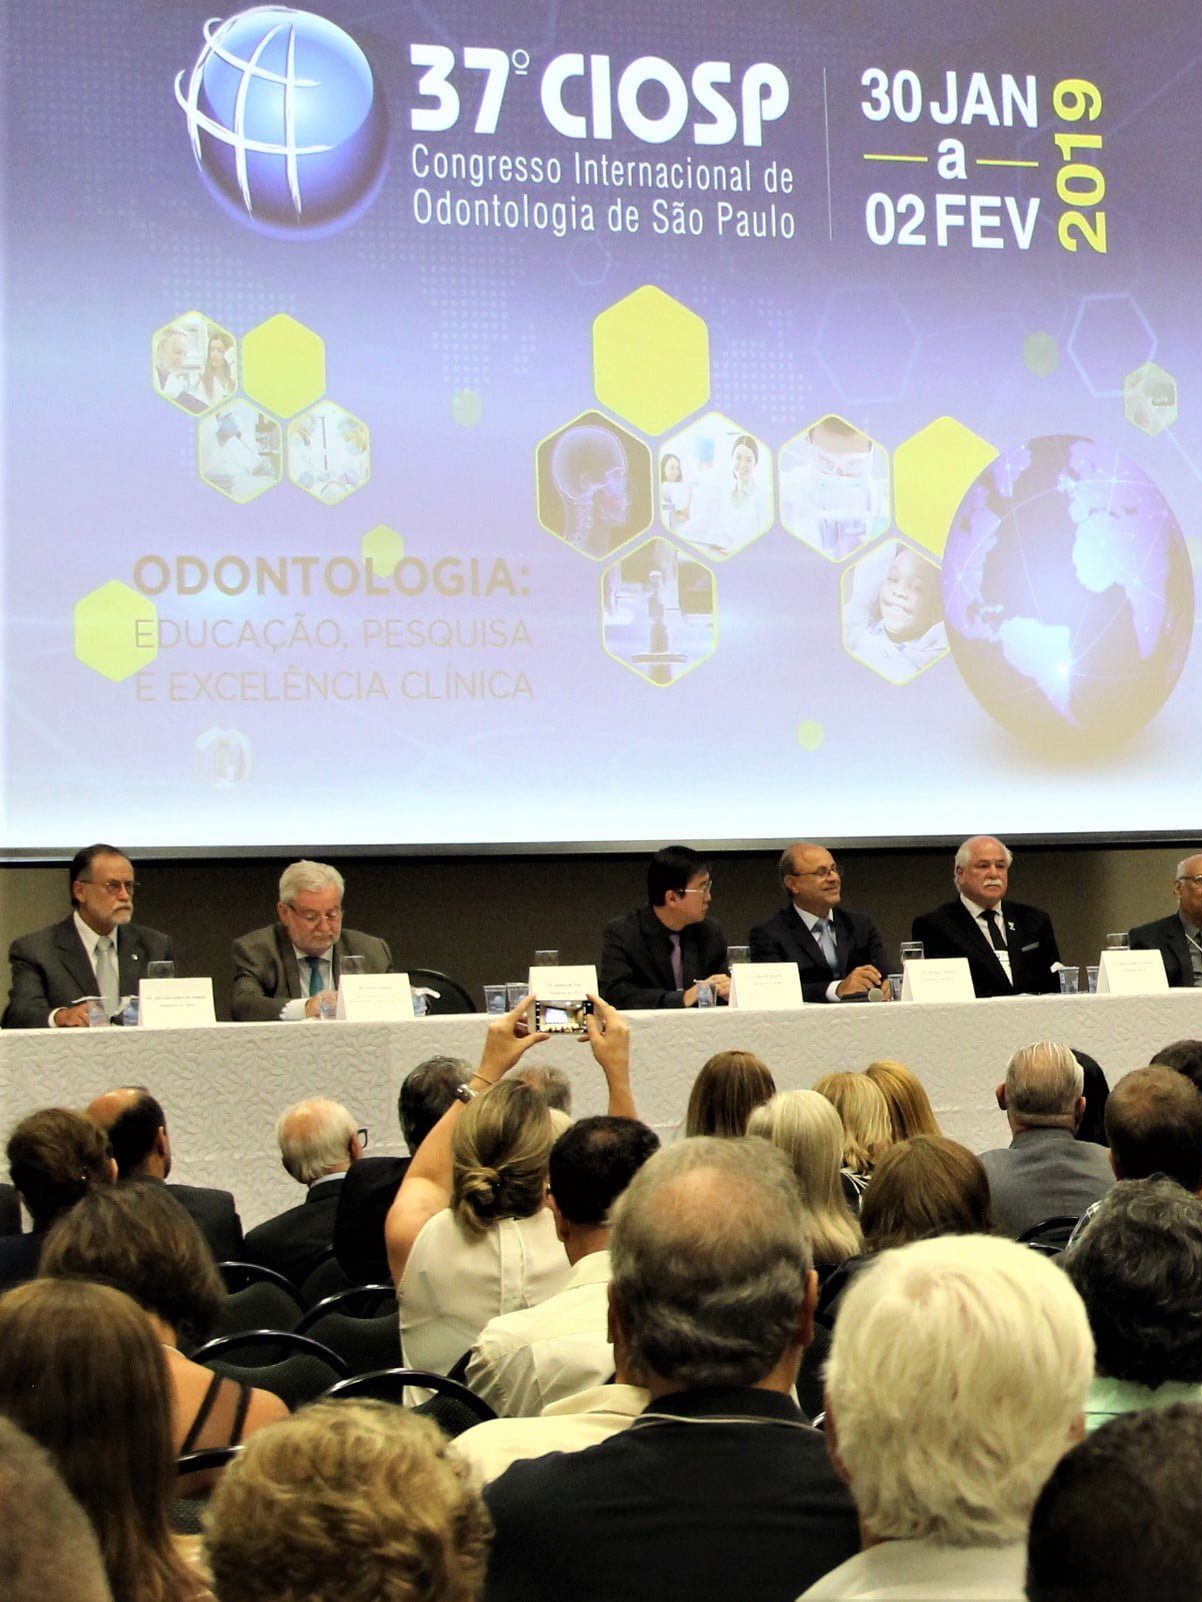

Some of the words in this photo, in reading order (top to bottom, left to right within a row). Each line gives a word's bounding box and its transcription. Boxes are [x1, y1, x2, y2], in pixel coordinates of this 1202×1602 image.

[541, 52, 790, 147] CIOSP
[861, 67, 922, 123] 30
[929, 70, 1038, 128] JAN
[411, 143, 561, 186] Congresso
[574, 151, 752, 192] Internacional
[763, 160, 794, 194] de
[937, 138, 968, 180] a
[1052, 78, 1107, 254] 2019
[413, 187, 595, 237] Odontologia
[608, 197, 639, 232] de
[652, 199, 703, 235] São
[717, 202, 795, 239] Paulo
[865, 191, 926, 246] 02
[935, 193, 1041, 250] FEV
[132, 553, 531, 597] ODONTOLOGIA:
[134, 612, 348, 653] EDUCAÇÃO,
[363, 618, 533, 650] PESQUISA
[135, 671, 157, 702] E
[169, 664, 389, 701] EXCELÊNCIA
[400, 663, 535, 700] CLÍNICA
